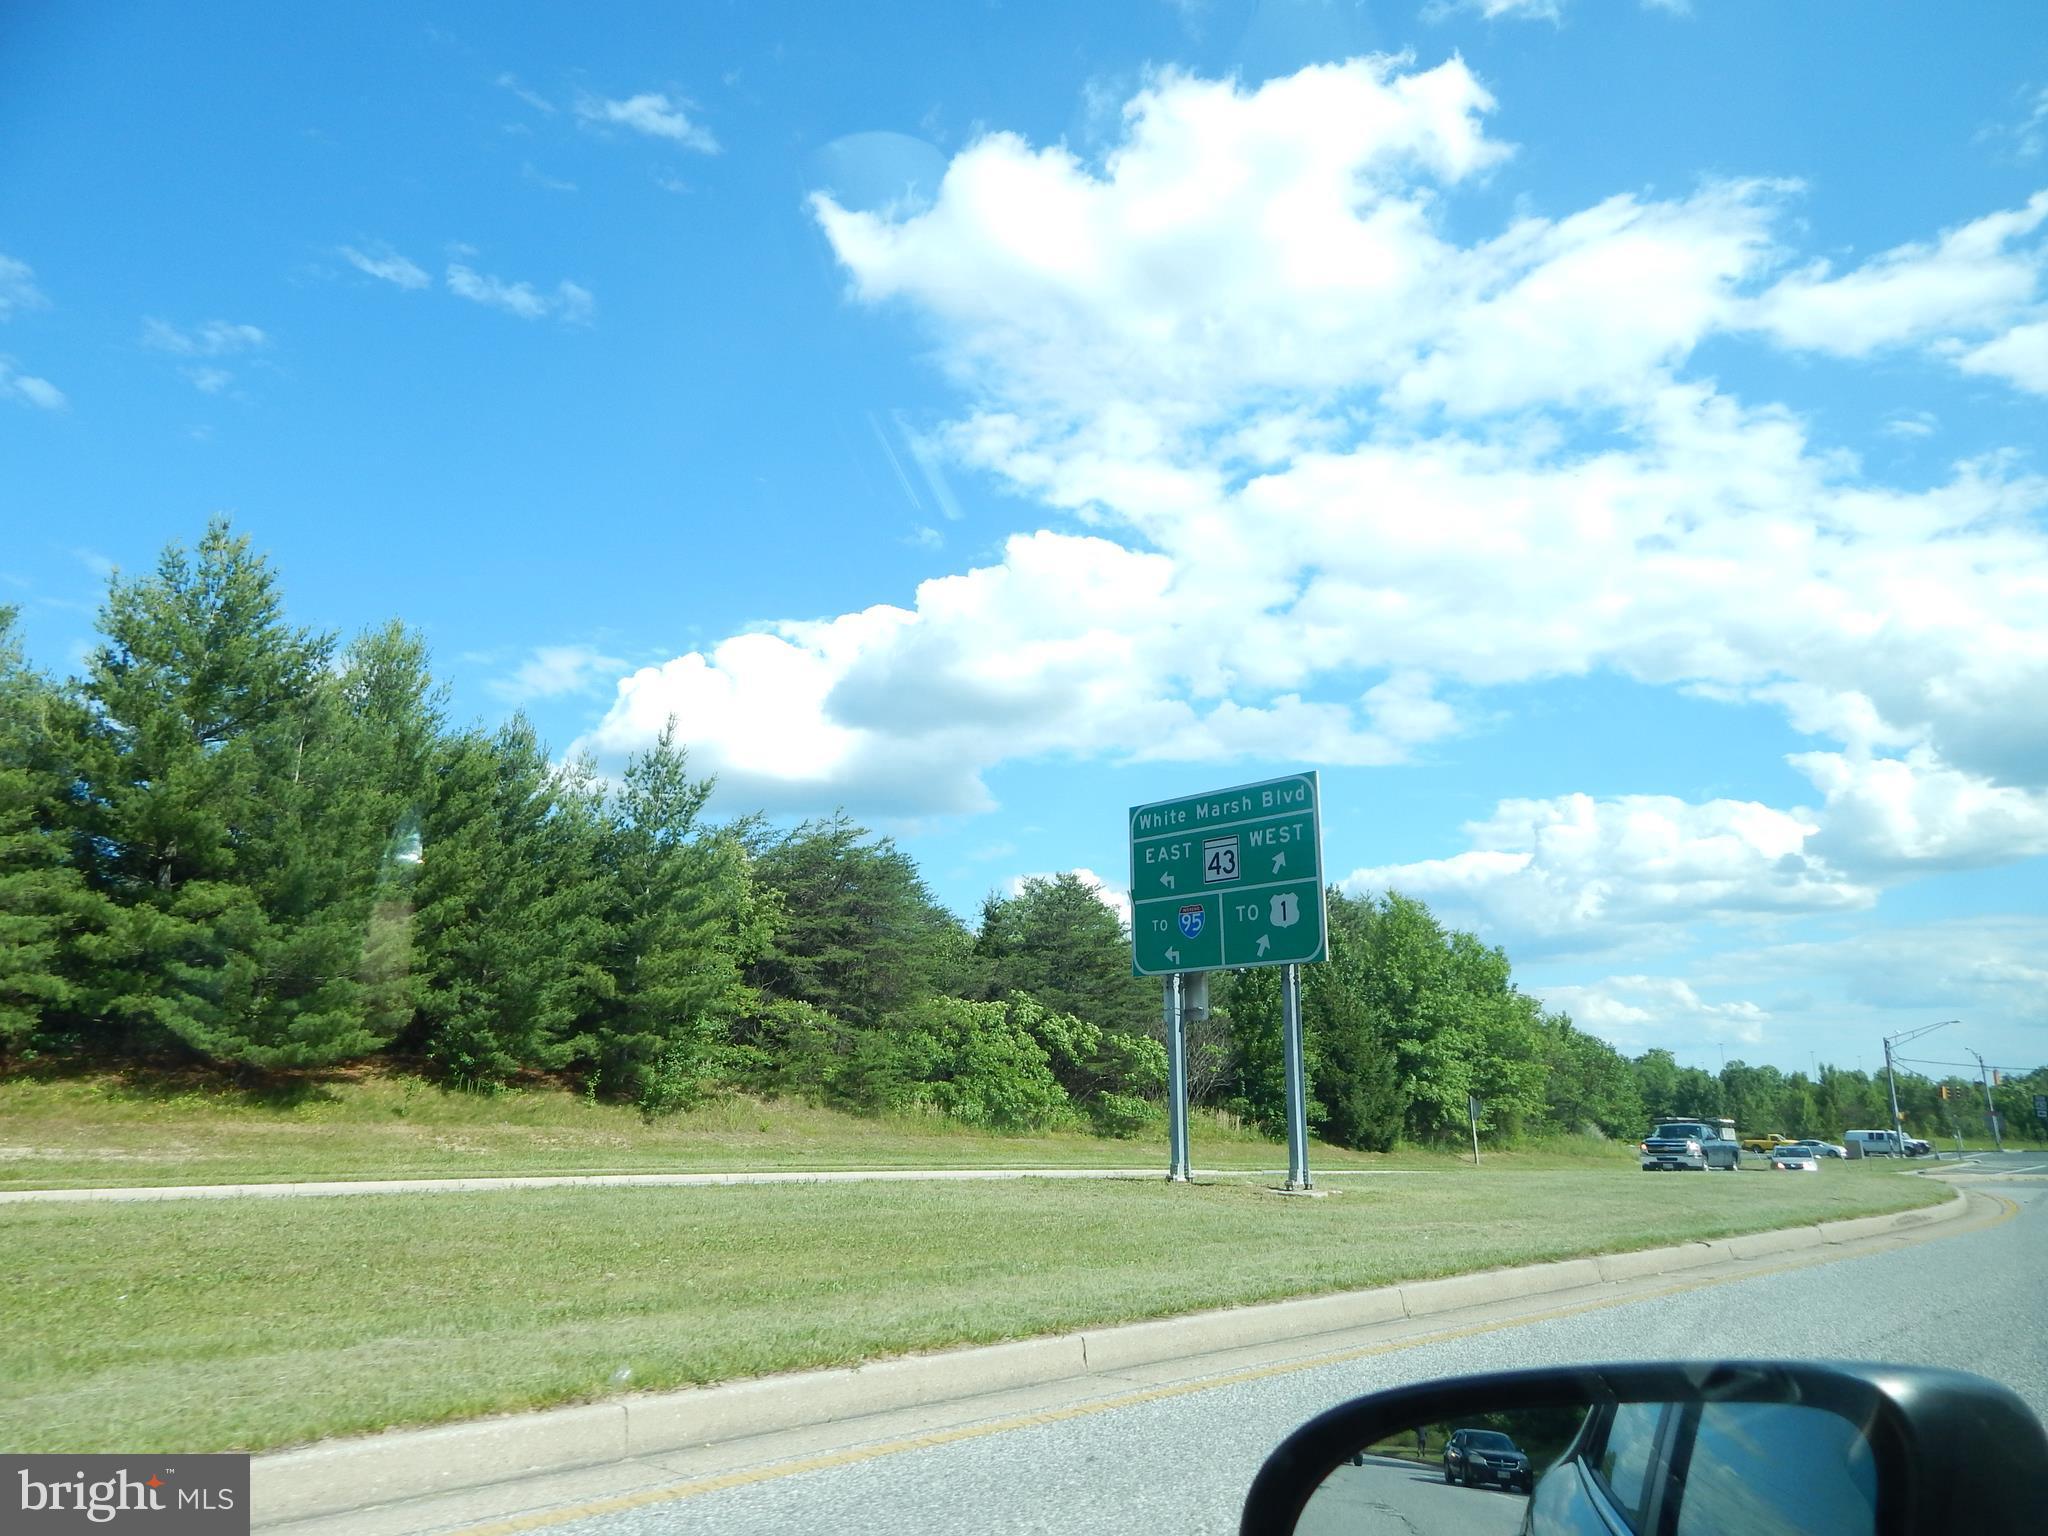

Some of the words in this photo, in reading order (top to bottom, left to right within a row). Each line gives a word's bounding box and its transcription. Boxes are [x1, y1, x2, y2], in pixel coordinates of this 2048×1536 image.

[1139, 809, 1186, 830] White
[1196, 796, 1251, 820] Marsh
[1262, 785, 1305, 808] Blvd
[1250, 824, 1303, 847] WEST
[1146, 842, 1192, 864] EAST
[1207, 850, 1236, 875] 43
[1236, 904, 1259, 922] TO
[1280, 900, 1287, 922] 1
[1152, 919, 1168, 932] TO
[1181, 914, 1203, 932] 95
